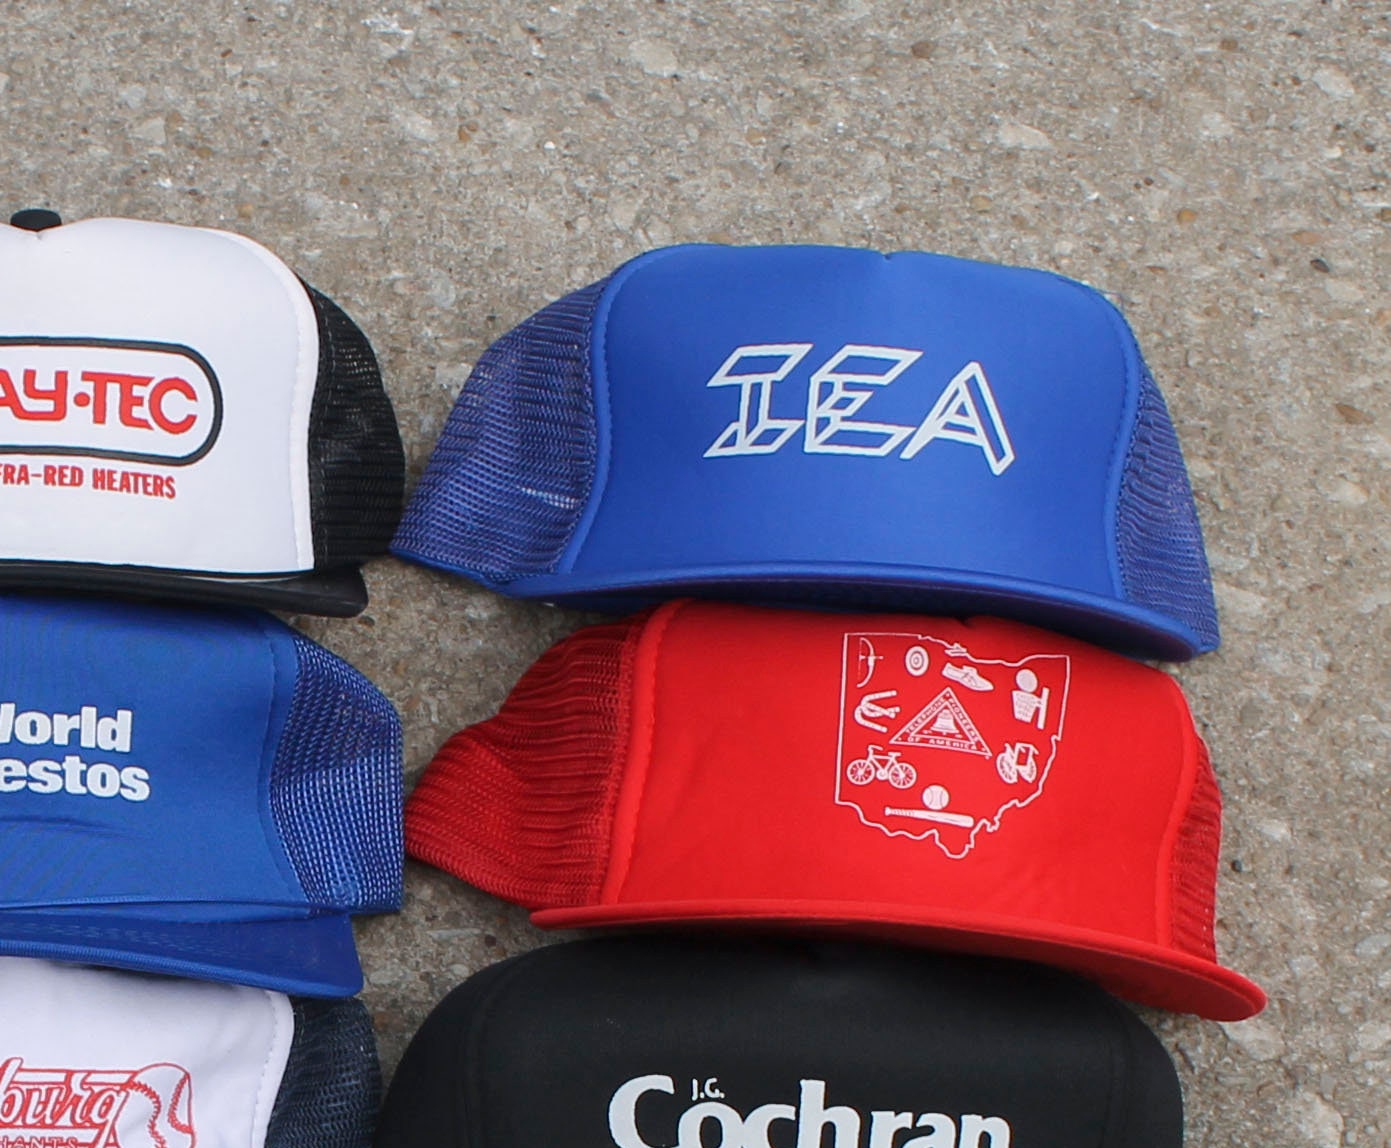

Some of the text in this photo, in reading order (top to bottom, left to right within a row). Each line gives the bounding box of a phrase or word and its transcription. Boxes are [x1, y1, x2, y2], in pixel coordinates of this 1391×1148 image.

[703, 342, 1016, 476] IEA
[92, 466, 177, 500] HEATERS
[691, 1078, 725, 1100] J.G.
